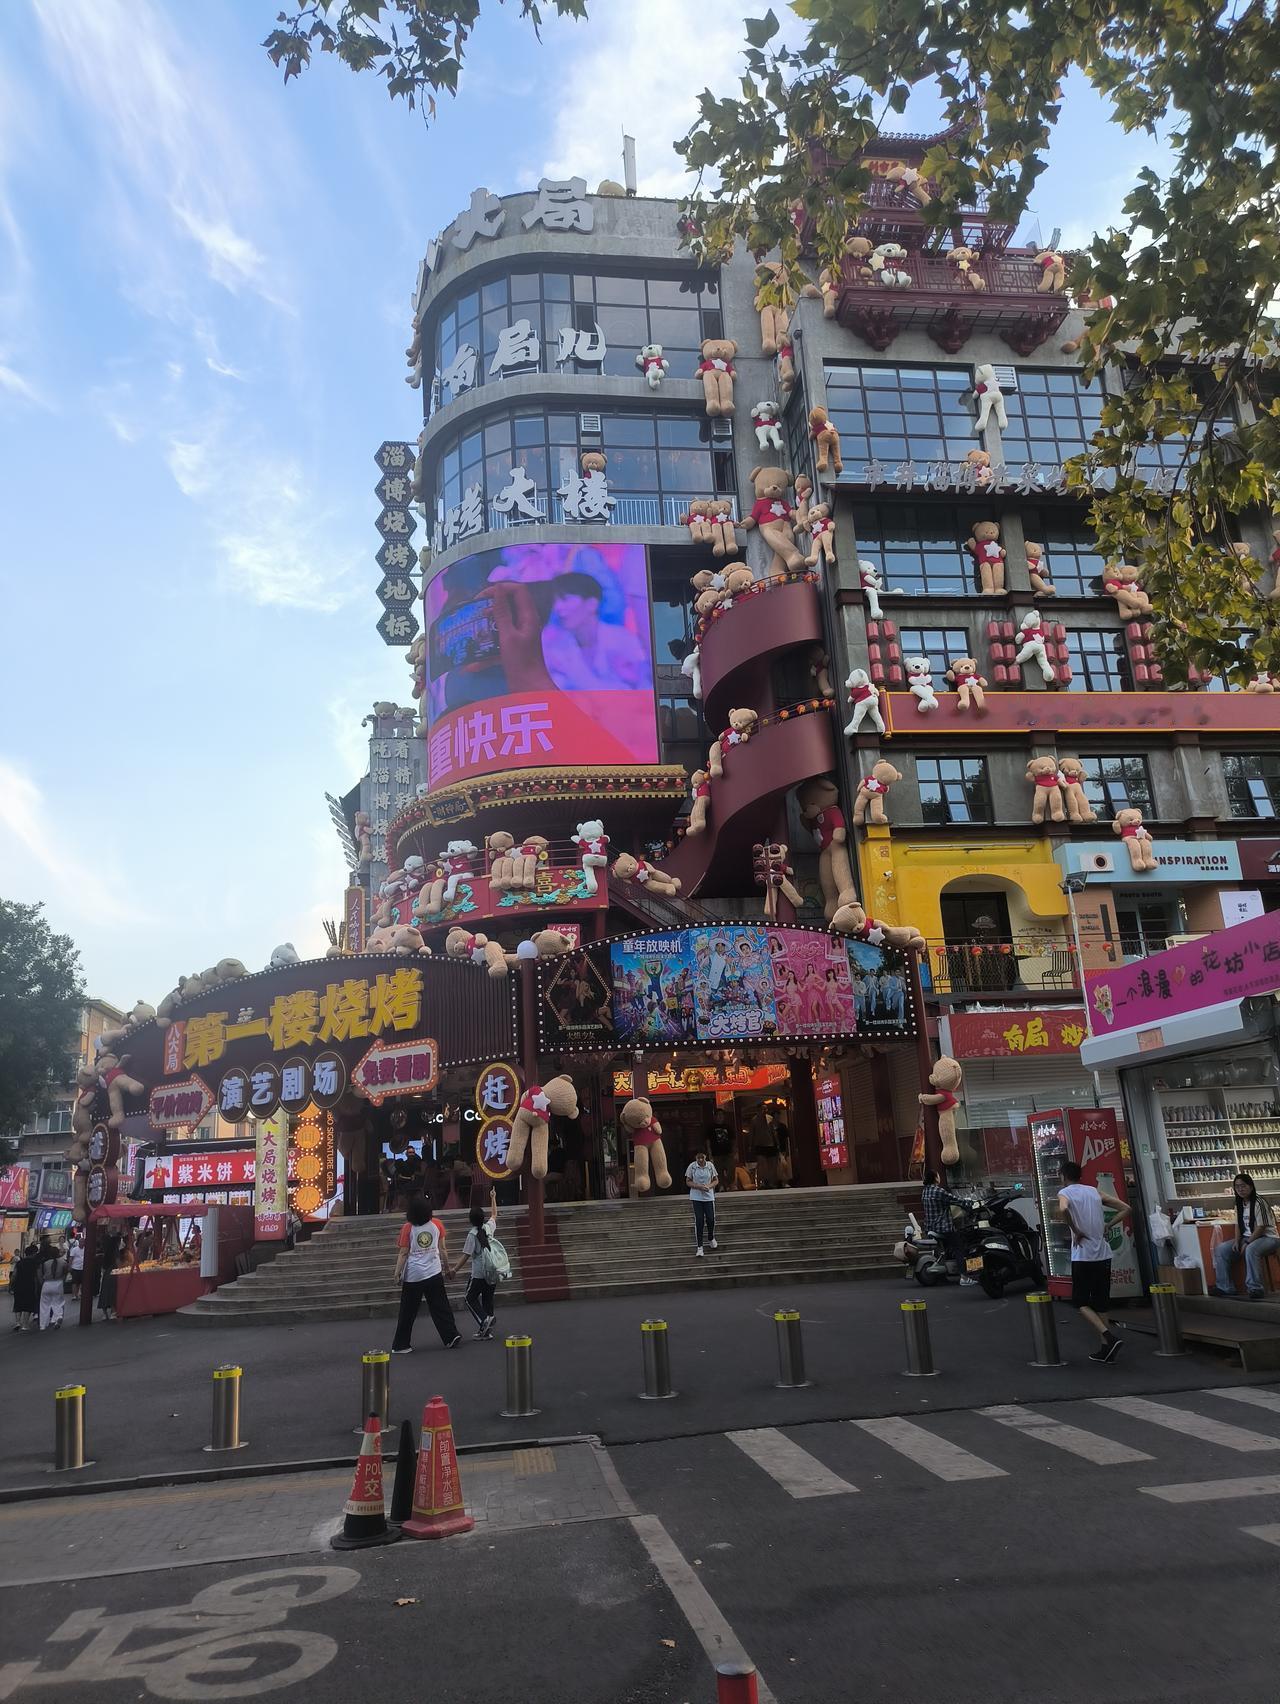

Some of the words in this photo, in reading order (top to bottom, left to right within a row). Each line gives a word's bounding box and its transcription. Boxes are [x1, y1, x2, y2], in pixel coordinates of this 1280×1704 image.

[383, 445, 412, 638] 淄博烧烤地标
[622, 939, 683, 954] 童年放映机
[183, 967, 424, 1070] 第一楼烧烤
[166, 1023, 181, 1070] 八大局
[221, 1060, 338, 1112] 演艺剧场
[362, 1053, 431, 1087] 免费看剧
[482, 1074, 511, 1165] 赶烤
[1080, 1120, 1108, 1131] 娃哈哈
[326, 1126, 334, 1170] SIGNATURE
[178, 1163, 233, 1183] 紫米饼
[326, 1171, 334, 1195] GRILL
[439, 1440, 454, 1506] 前置净水器
